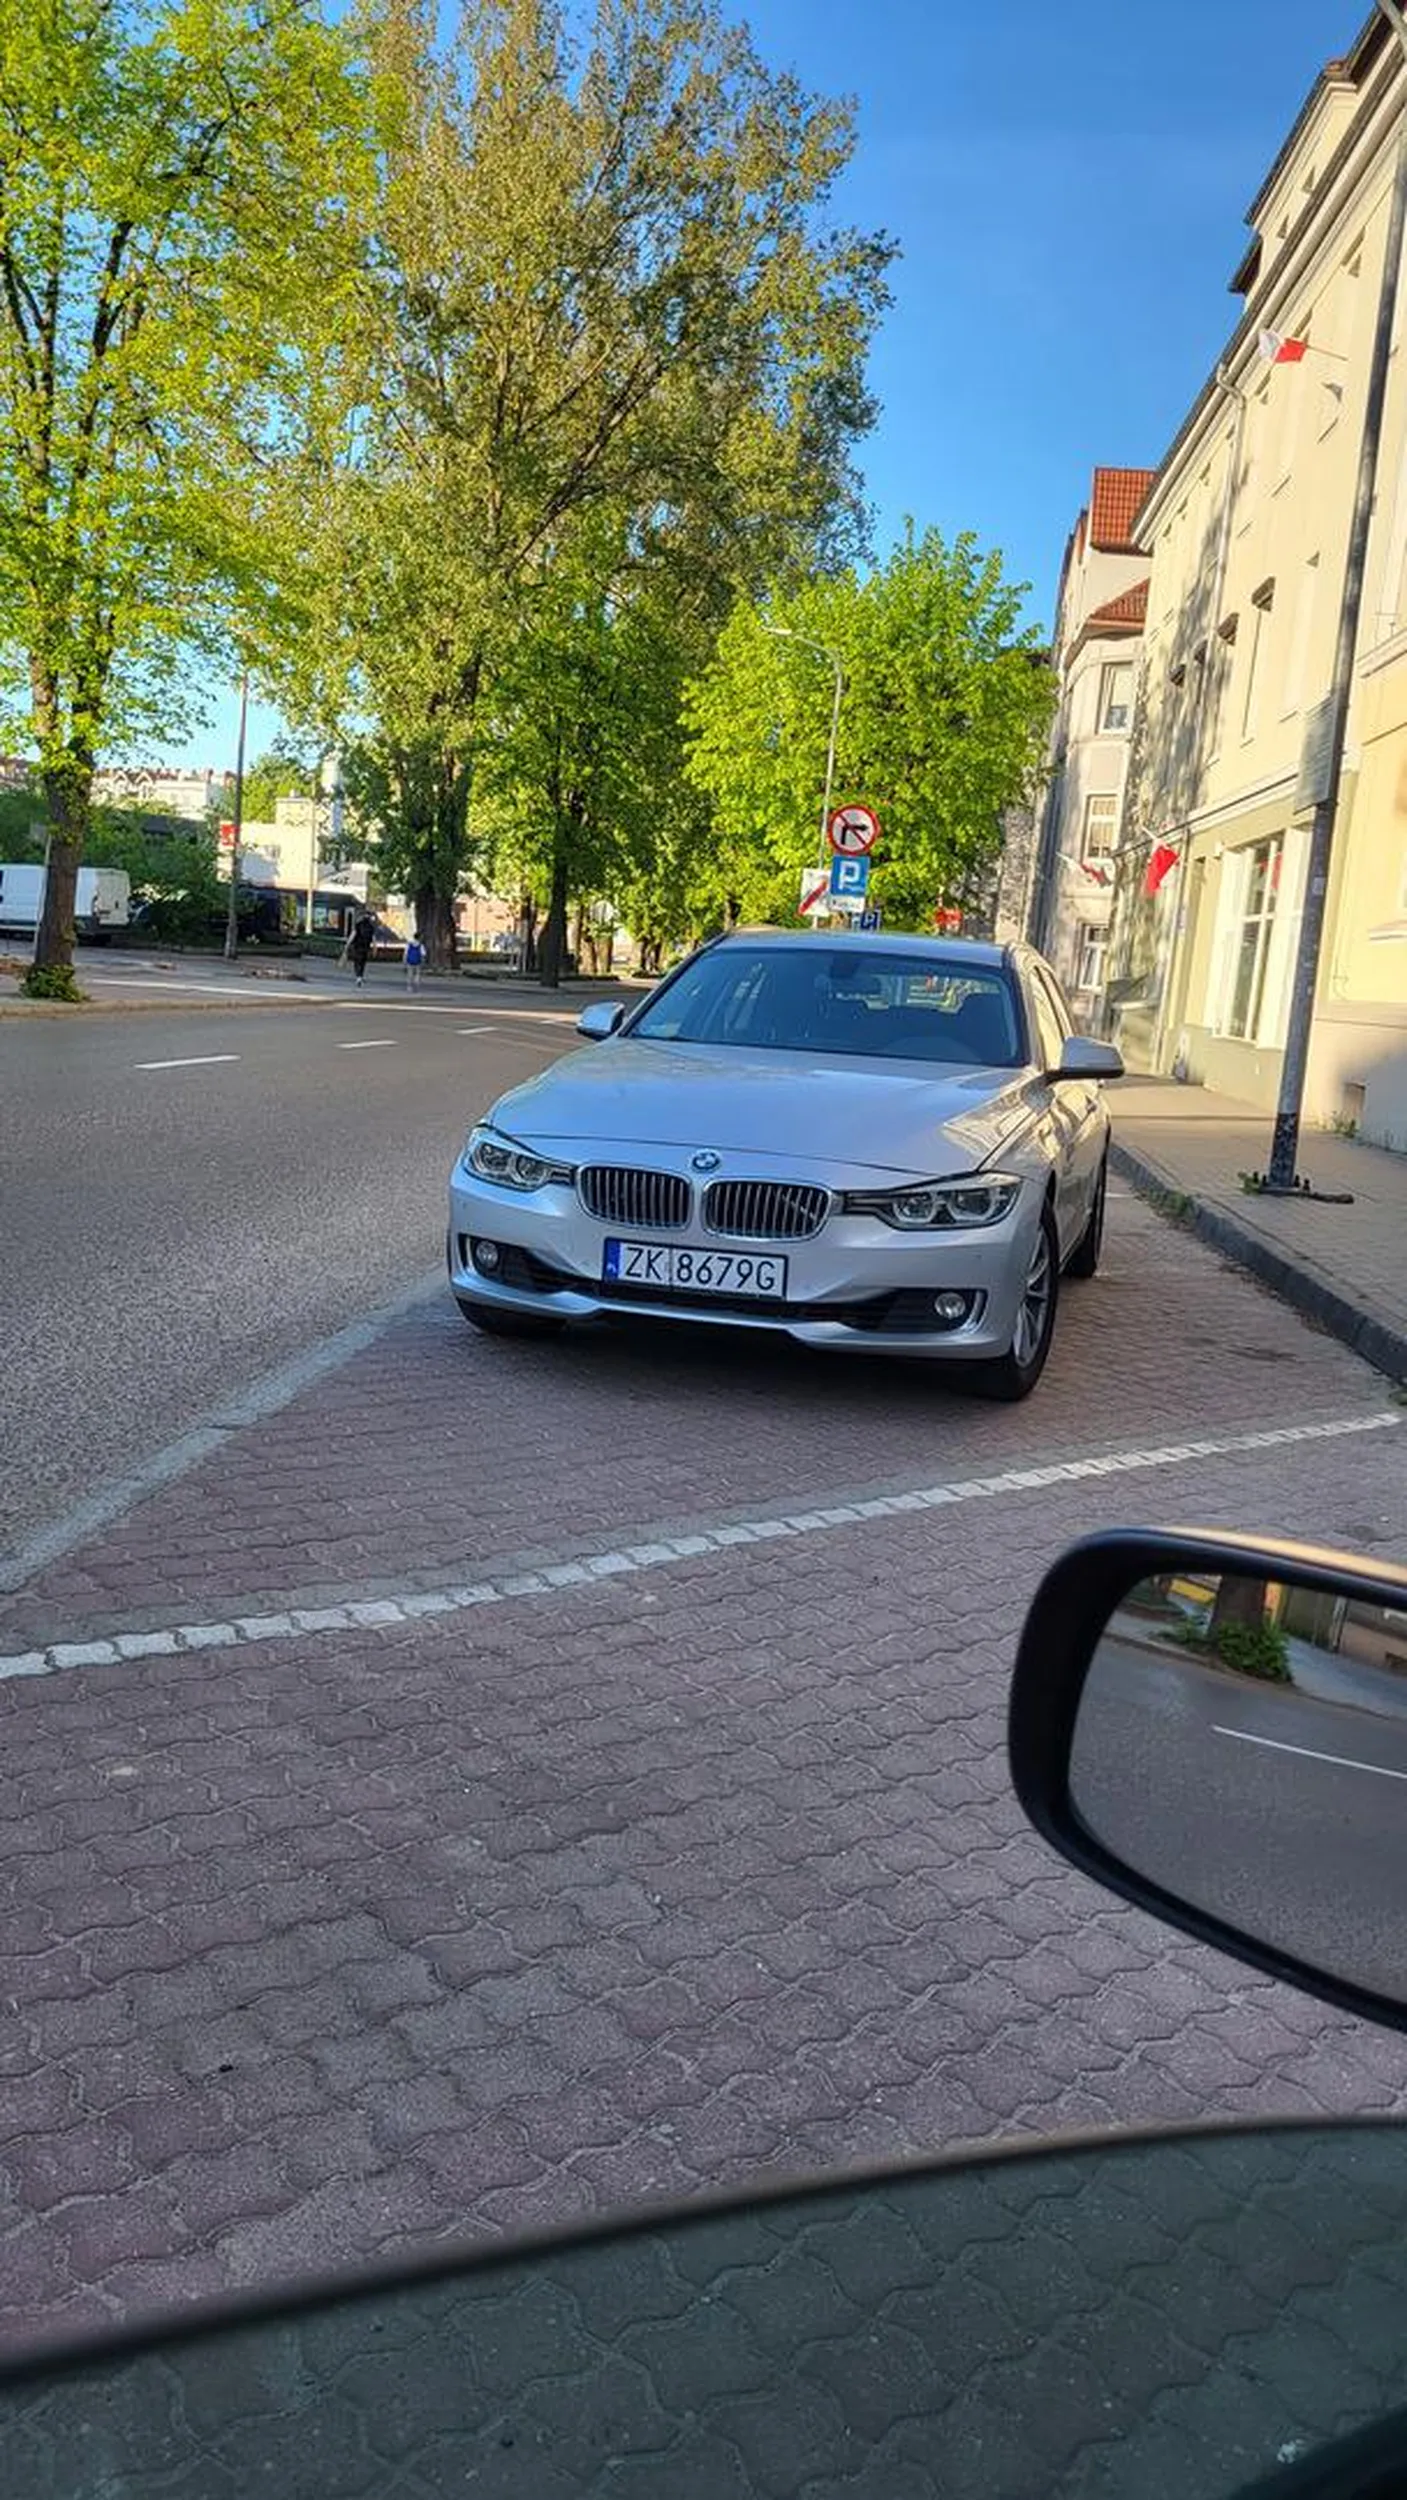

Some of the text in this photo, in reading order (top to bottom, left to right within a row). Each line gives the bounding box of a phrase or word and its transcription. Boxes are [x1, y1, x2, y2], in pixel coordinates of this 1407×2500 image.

[838, 860, 861, 890] P
[625, 1247, 776, 1291] ZK 8679G
